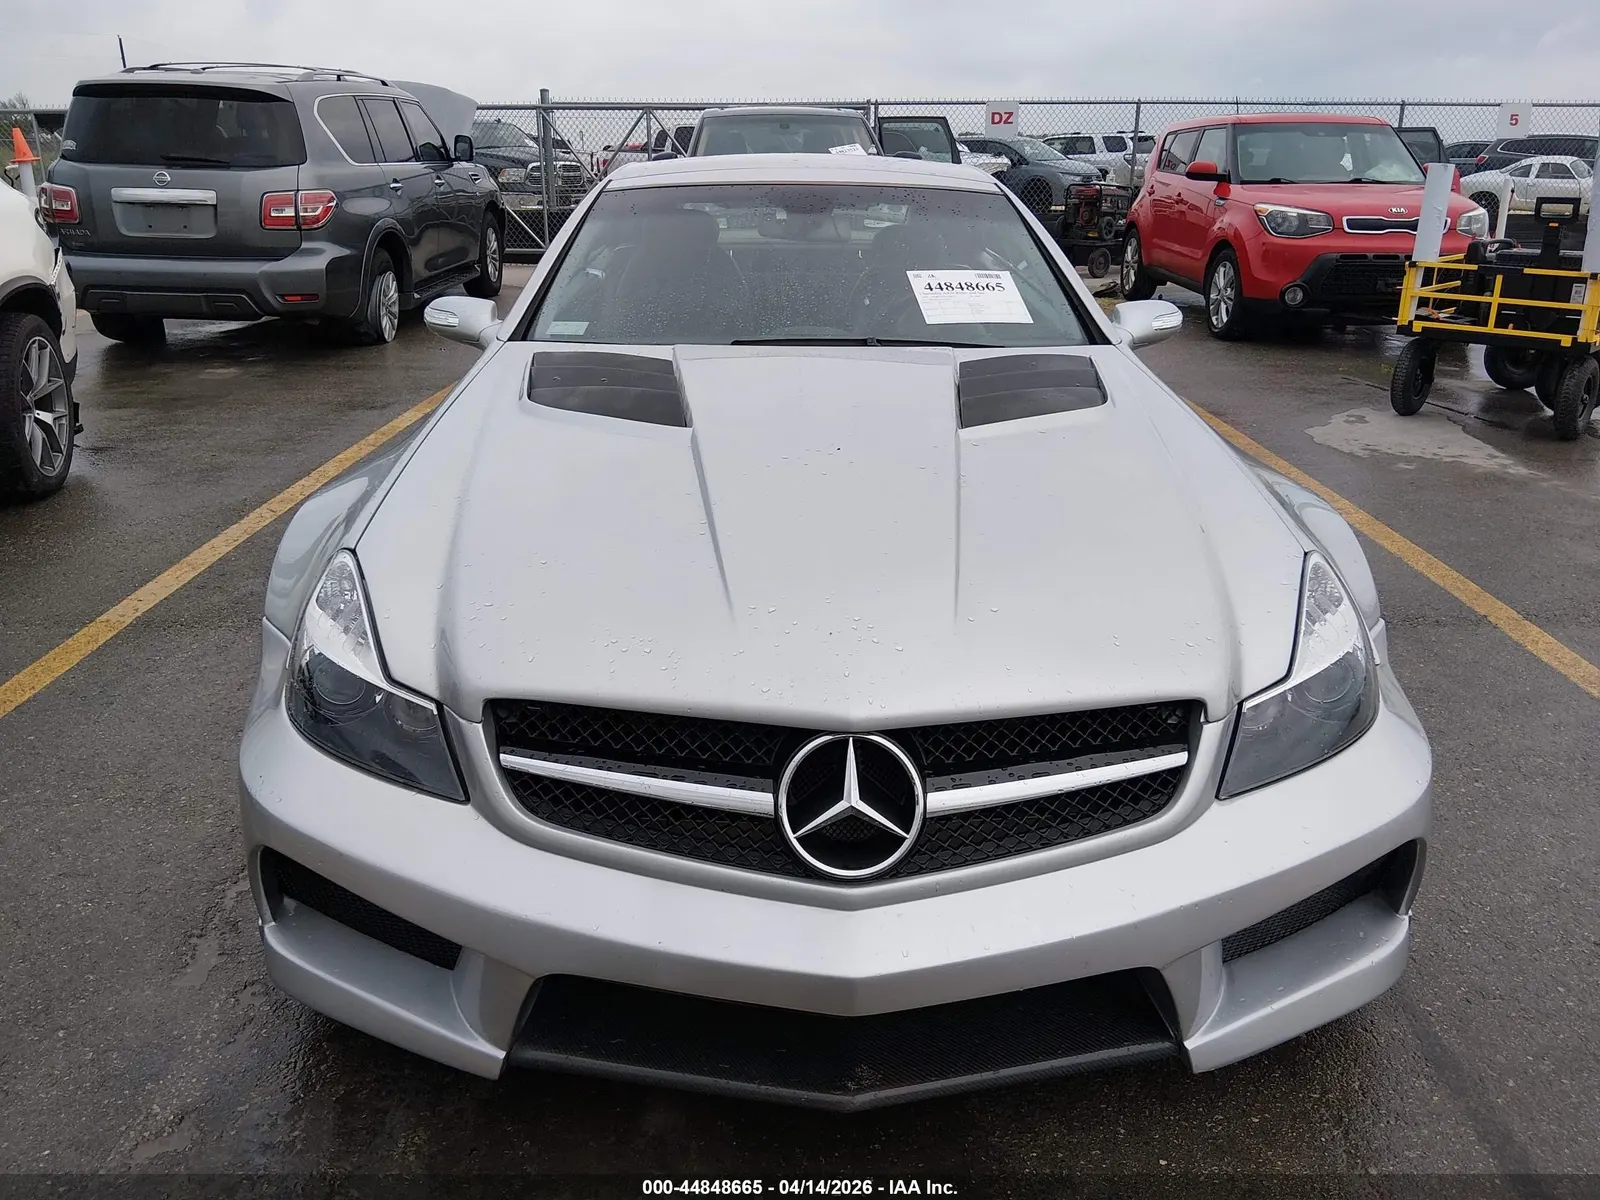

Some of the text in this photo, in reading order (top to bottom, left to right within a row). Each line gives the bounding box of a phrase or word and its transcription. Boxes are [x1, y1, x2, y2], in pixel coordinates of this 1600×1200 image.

[991, 112, 1014, 124] DZ
[1509, 114, 1519, 126] 5
[923, 281, 1006, 292] 44848665
